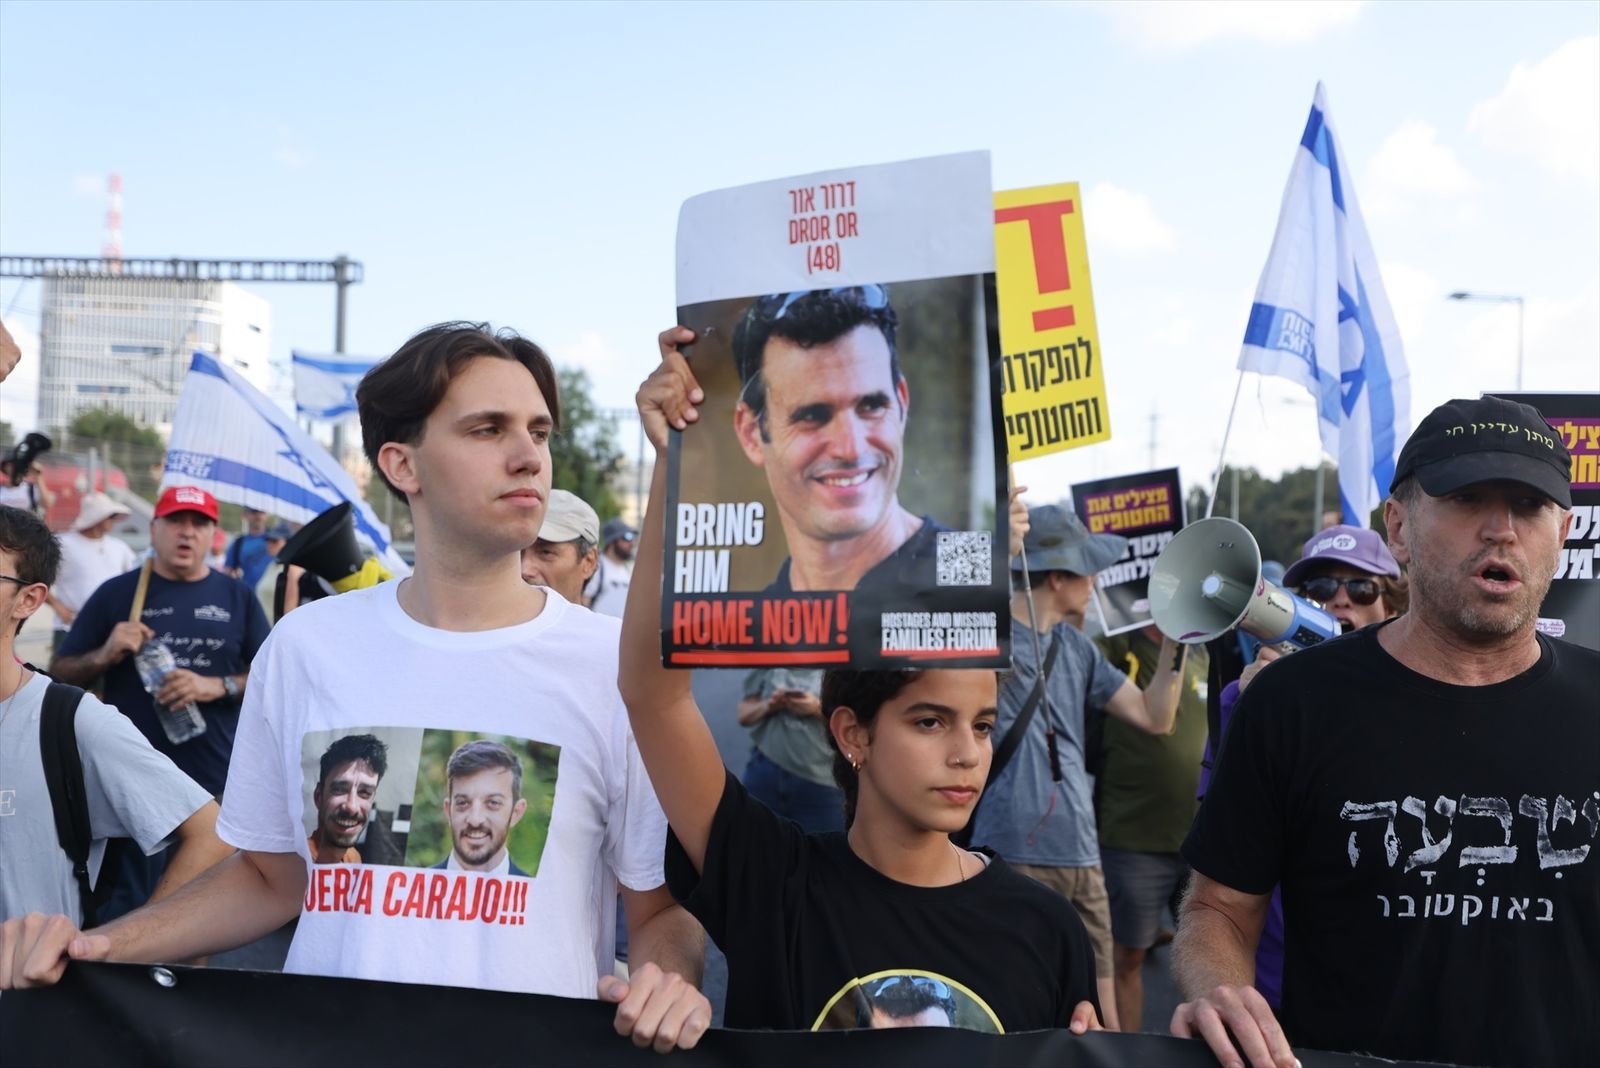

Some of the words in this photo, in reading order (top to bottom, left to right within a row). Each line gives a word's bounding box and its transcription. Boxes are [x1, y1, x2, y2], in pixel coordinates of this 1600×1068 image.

[788, 186, 815, 214] אור
[819, 181, 855, 210] דרור
[789, 215, 830, 245] DROR
[836, 212, 858, 238] OR
[807, 242, 840, 274] (48)
[1005, 397, 1103, 451] והחטופי
[1446, 426, 1464, 436] חי
[1524, 428, 1554, 449] מתן
[675, 502, 764, 546] BRING
[1088, 504, 1170, 533] החטופים
[674, 550, 730, 593] HIM
[673, 601, 753, 645] HOME
[762, 592, 848, 645] NOW!
[881, 612, 931, 628] HOSTAGES
[932, 612, 952, 628] AND
[952, 612, 997, 628] MISSING
[882, 628, 944, 650] FAMILIES
[946, 628, 997, 650] FORUM
[382, 871, 528, 926] CARAJO!!!
[1377, 893, 1554, 926] באוקטובר
